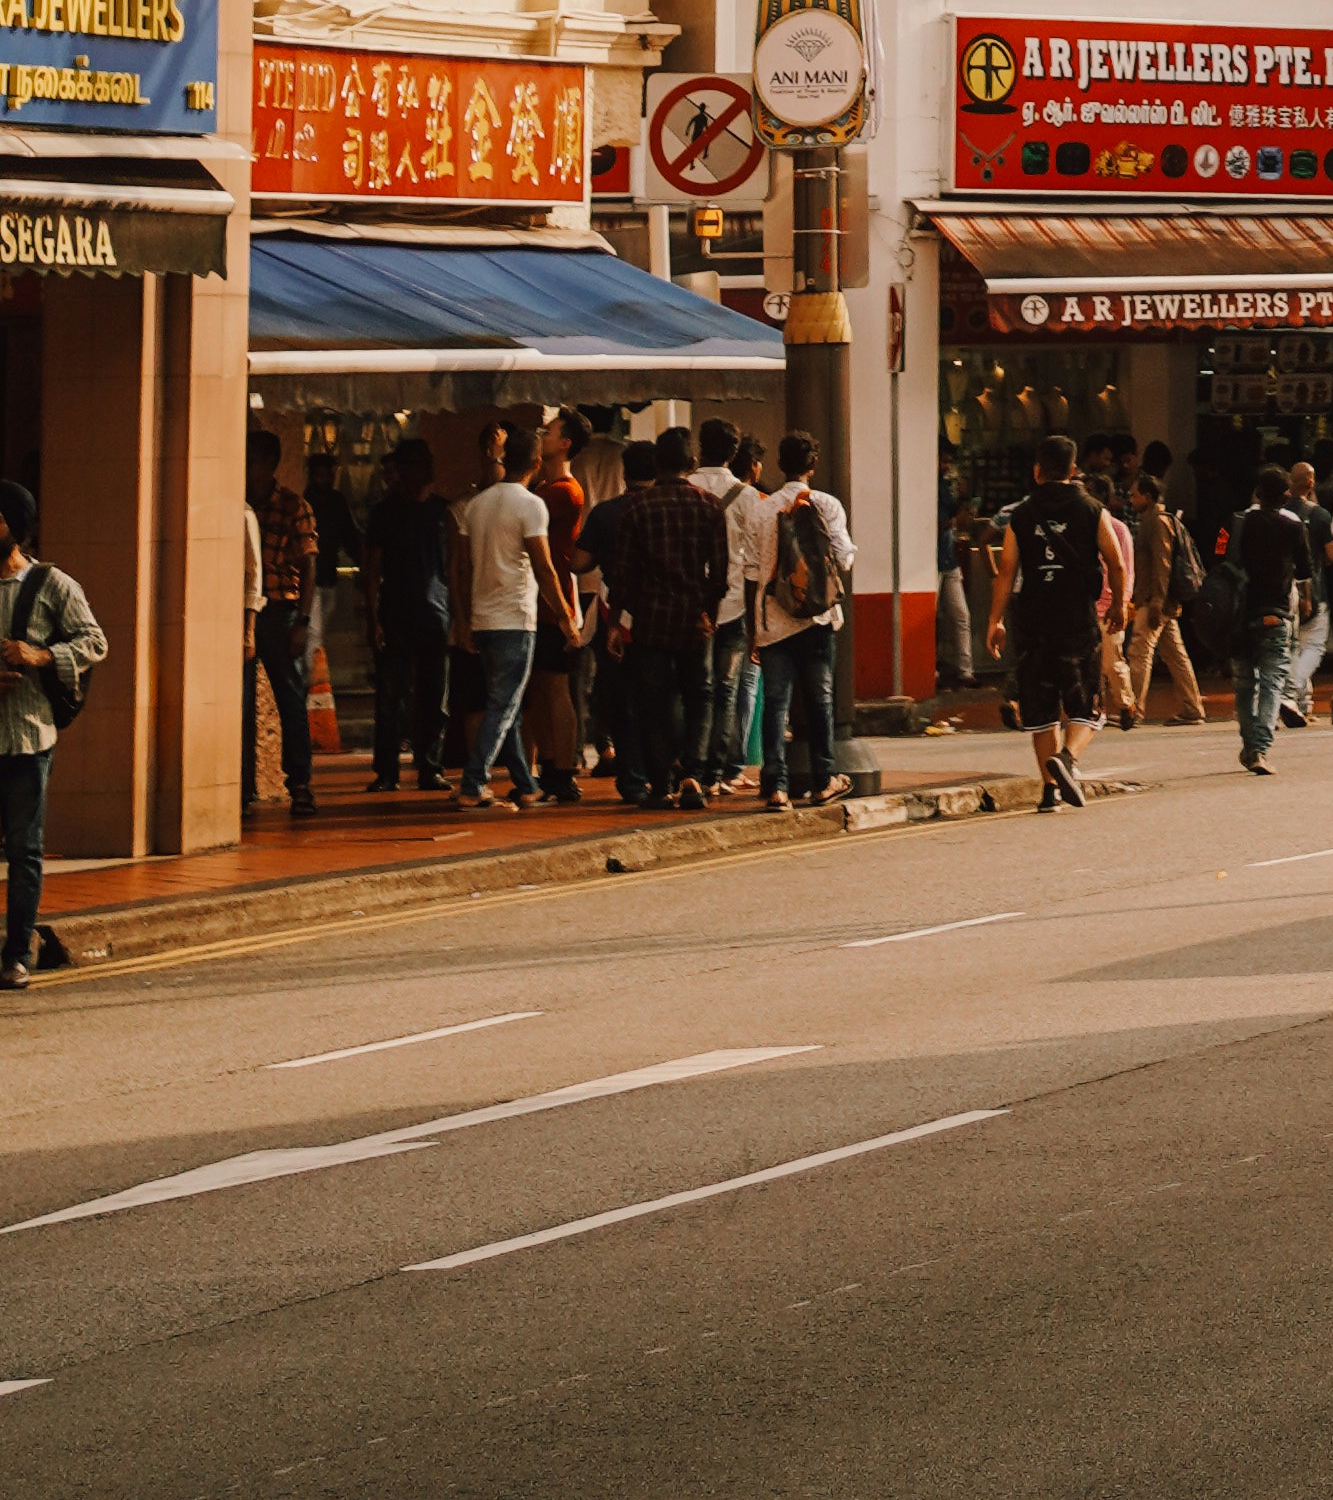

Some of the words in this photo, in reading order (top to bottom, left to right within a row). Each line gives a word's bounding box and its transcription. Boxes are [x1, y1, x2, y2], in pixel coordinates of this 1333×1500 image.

[769, 71, 798, 85] ANI
[804, 70, 848, 84] MANI
[1076, 39, 1249, 90] JEWELLERS
[187, 81, 214, 110] 114
[1120, 292, 1289, 326] JEWELLERS
